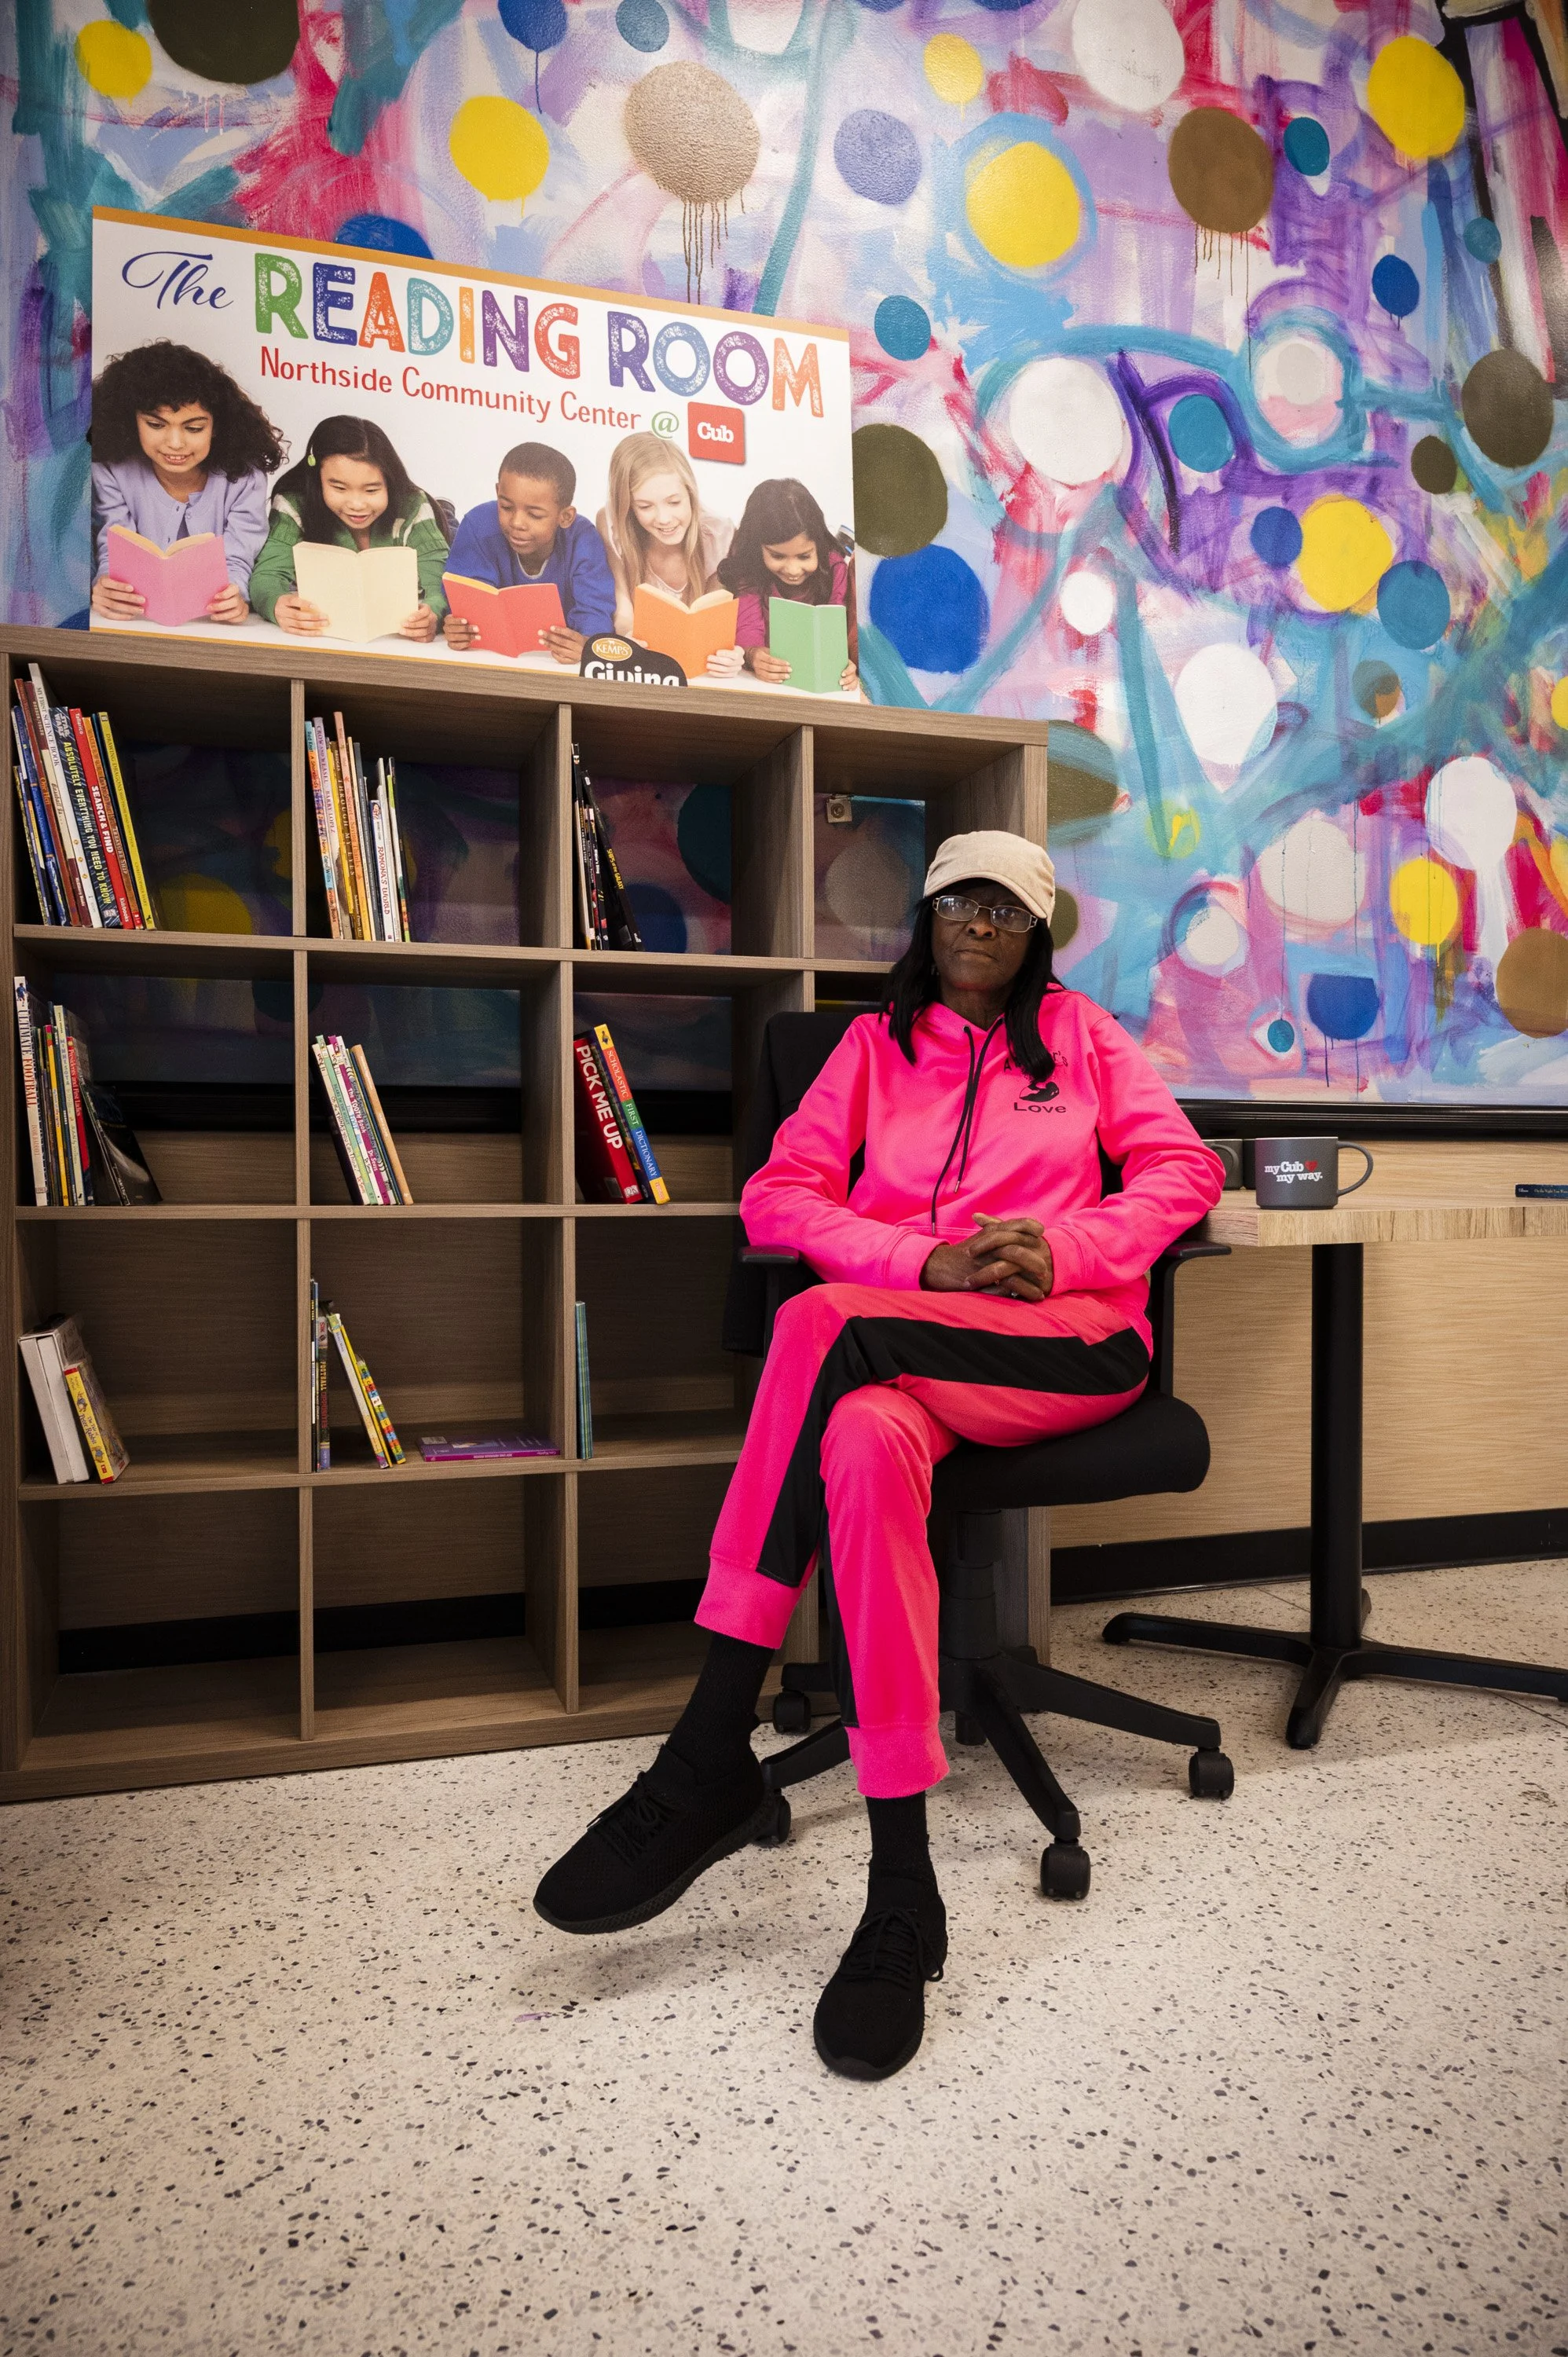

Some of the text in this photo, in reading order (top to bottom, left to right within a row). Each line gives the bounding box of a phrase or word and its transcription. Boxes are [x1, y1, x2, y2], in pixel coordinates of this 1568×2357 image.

[122, 251, 824, 418] The READING ROOM
[261, 346, 680, 438] Northside Community Center @
[697, 420, 734, 443] Cub
[595, 643, 628, 655] KEMPS
[36, 687, 42, 696] MY
[42, 714, 55, 744] SCIENCE
[50, 746, 60, 766] BOOK
[54, 713, 65, 738] WARS
[59, 712, 71, 738] STAR
[75, 713, 84, 735] Tallarico
[316, 725, 325, 744] CROW
[63, 741, 82, 787] ABSOLUTELY
[106, 733, 116, 761] DRAWING
[112, 763, 123, 791] DRAGONS
[321, 758, 329, 783] WEASEL
[75, 788, 93, 834] EVERYTHING
[324, 790, 333, 812] BARRY
[338, 779, 348, 827] THROUGH
[344, 832, 351, 845] MY
[91, 785, 106, 823] SEARCH
[102, 830, 114, 854] FIND
[349, 821, 357, 844] Saying
[86, 834, 97, 849] YOU
[112, 827, 124, 858] TREASURE
[90, 850, 102, 871] NEED
[378, 846, 389, 884] RAMONA'S
[606, 849, 616, 863] SHIPS
[614, 872, 624, 889] GALAXY
[96, 871, 105, 881] TO
[134, 862, 145, 893] CHRISTOPHER
[324, 868, 334, 882] Willis
[98, 882, 111, 905] KNOW
[381, 887, 390, 915] WORLD
[18, 1009, 32, 1056] ULTIMATE
[23, 1058, 38, 1108] FOOTBALL
[577, 1045, 623, 1149] PICK ME UP
[350, 1080, 361, 1098] Scaredy
[356, 1098, 367, 1116] Squirrel
[1013, 1102, 1067, 1113] Love
[607, 1050, 658, 1176] SCHOLASTIC FIRST DICTIONARY
[350, 1099, 363, 1120] TOOTH
[370, 1157, 379, 1171] Seuss
[1264, 1161, 1304, 1175] my Cub
[1276, 1172, 1323, 1184] my way.
[624, 1184, 639, 1197] DK
[366, 1380, 376, 1398] CARLE
[79, 1413, 97, 1444] Peter Rabbit
